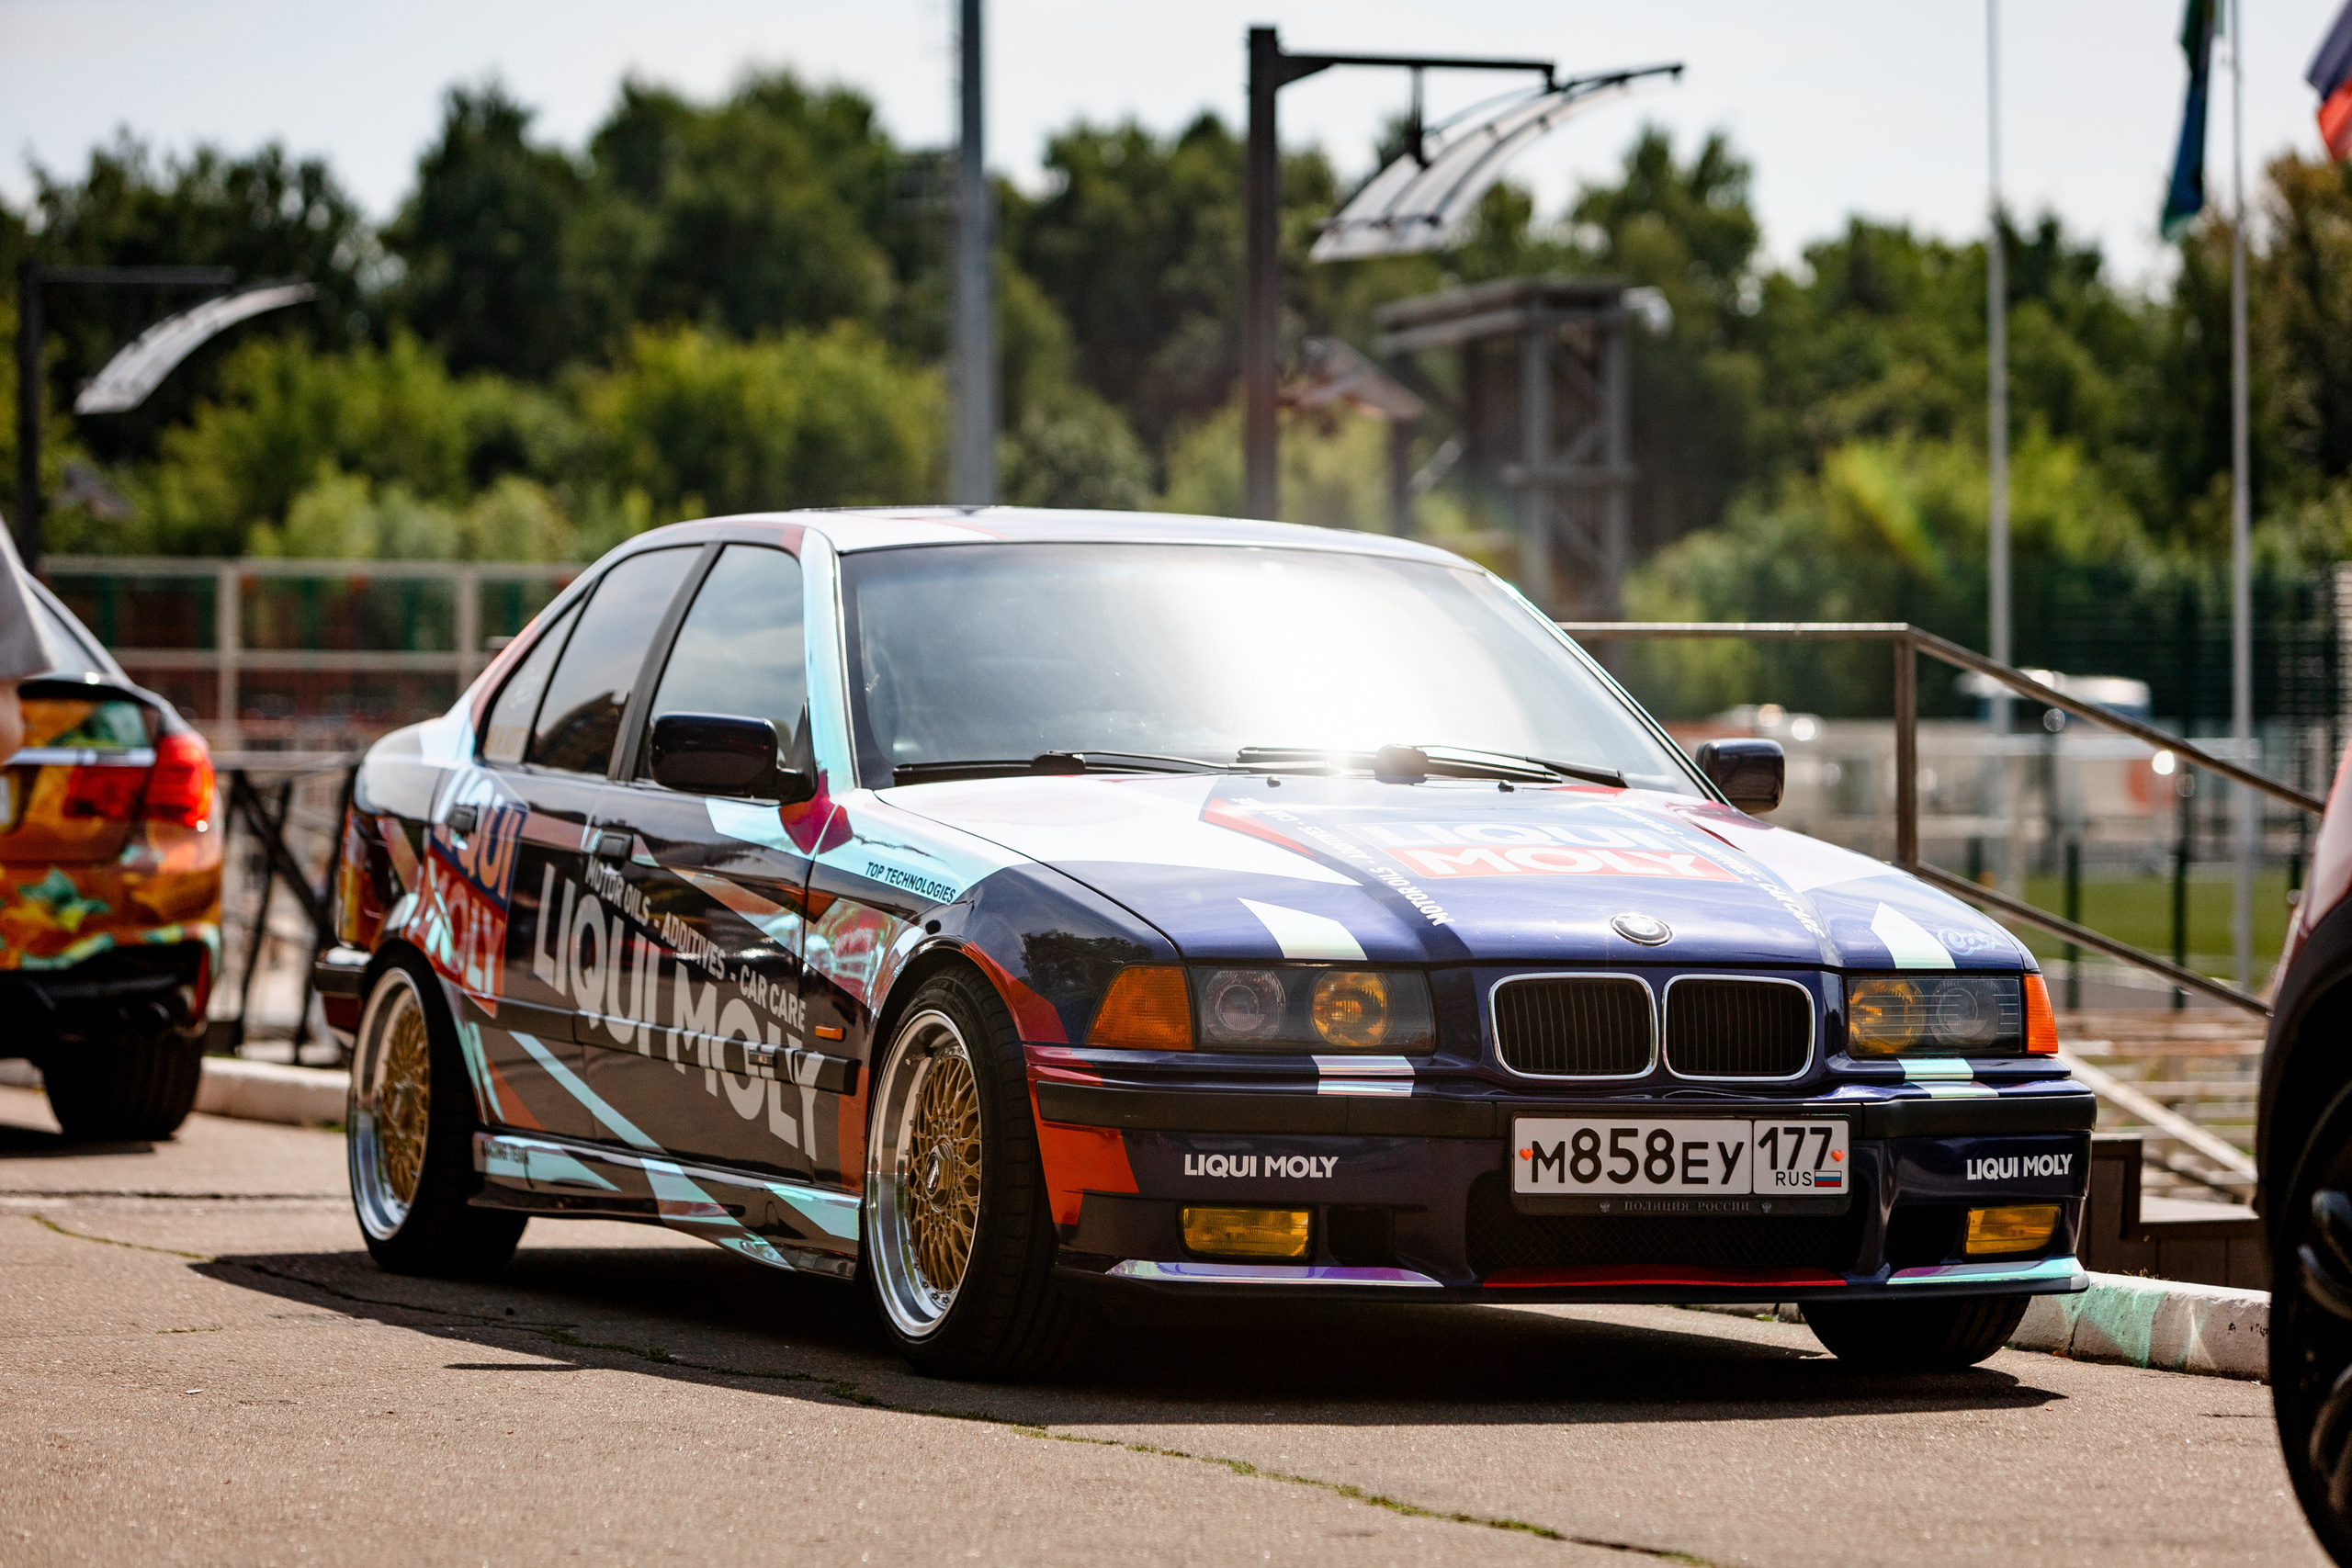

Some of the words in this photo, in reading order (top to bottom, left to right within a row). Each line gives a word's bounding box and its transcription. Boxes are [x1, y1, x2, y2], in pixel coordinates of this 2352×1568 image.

[1297, 826, 1370, 860] ADDITIVES
[1360, 823, 1675, 852] LIQUI
[1369, 866, 1410, 887] OILS
[1402, 847, 1706, 878] MOLY
[865, 862, 885, 879] TOP
[885, 867, 956, 904] TECHNOLOGIES
[1397, 886, 1455, 926] MOTOR
[584, 854, 626, 908] MOTOR
[624, 884, 651, 928] OILS
[661, 911, 727, 980] ADDITIVES
[740, 964, 768, 1010] CAR
[770, 983, 807, 1032] CARE
[533, 862, 661, 1057] LIQUI
[666, 960, 825, 1162] MOLY
[1758, 1126, 1833, 1170] 177
[1184, 1154, 1258, 1179] LIQUI
[1264, 1156, 1340, 1179] MOLY
[1775, 1171, 1813, 1187] RUS
[1966, 1157, 2018, 1180] LIQUI
[2023, 1154, 2073, 1177] MOLY
[1624, 1201, 1690, 1213] ПОЛИЦИЯ
[1699, 1201, 1749, 1212] РОССИИ
